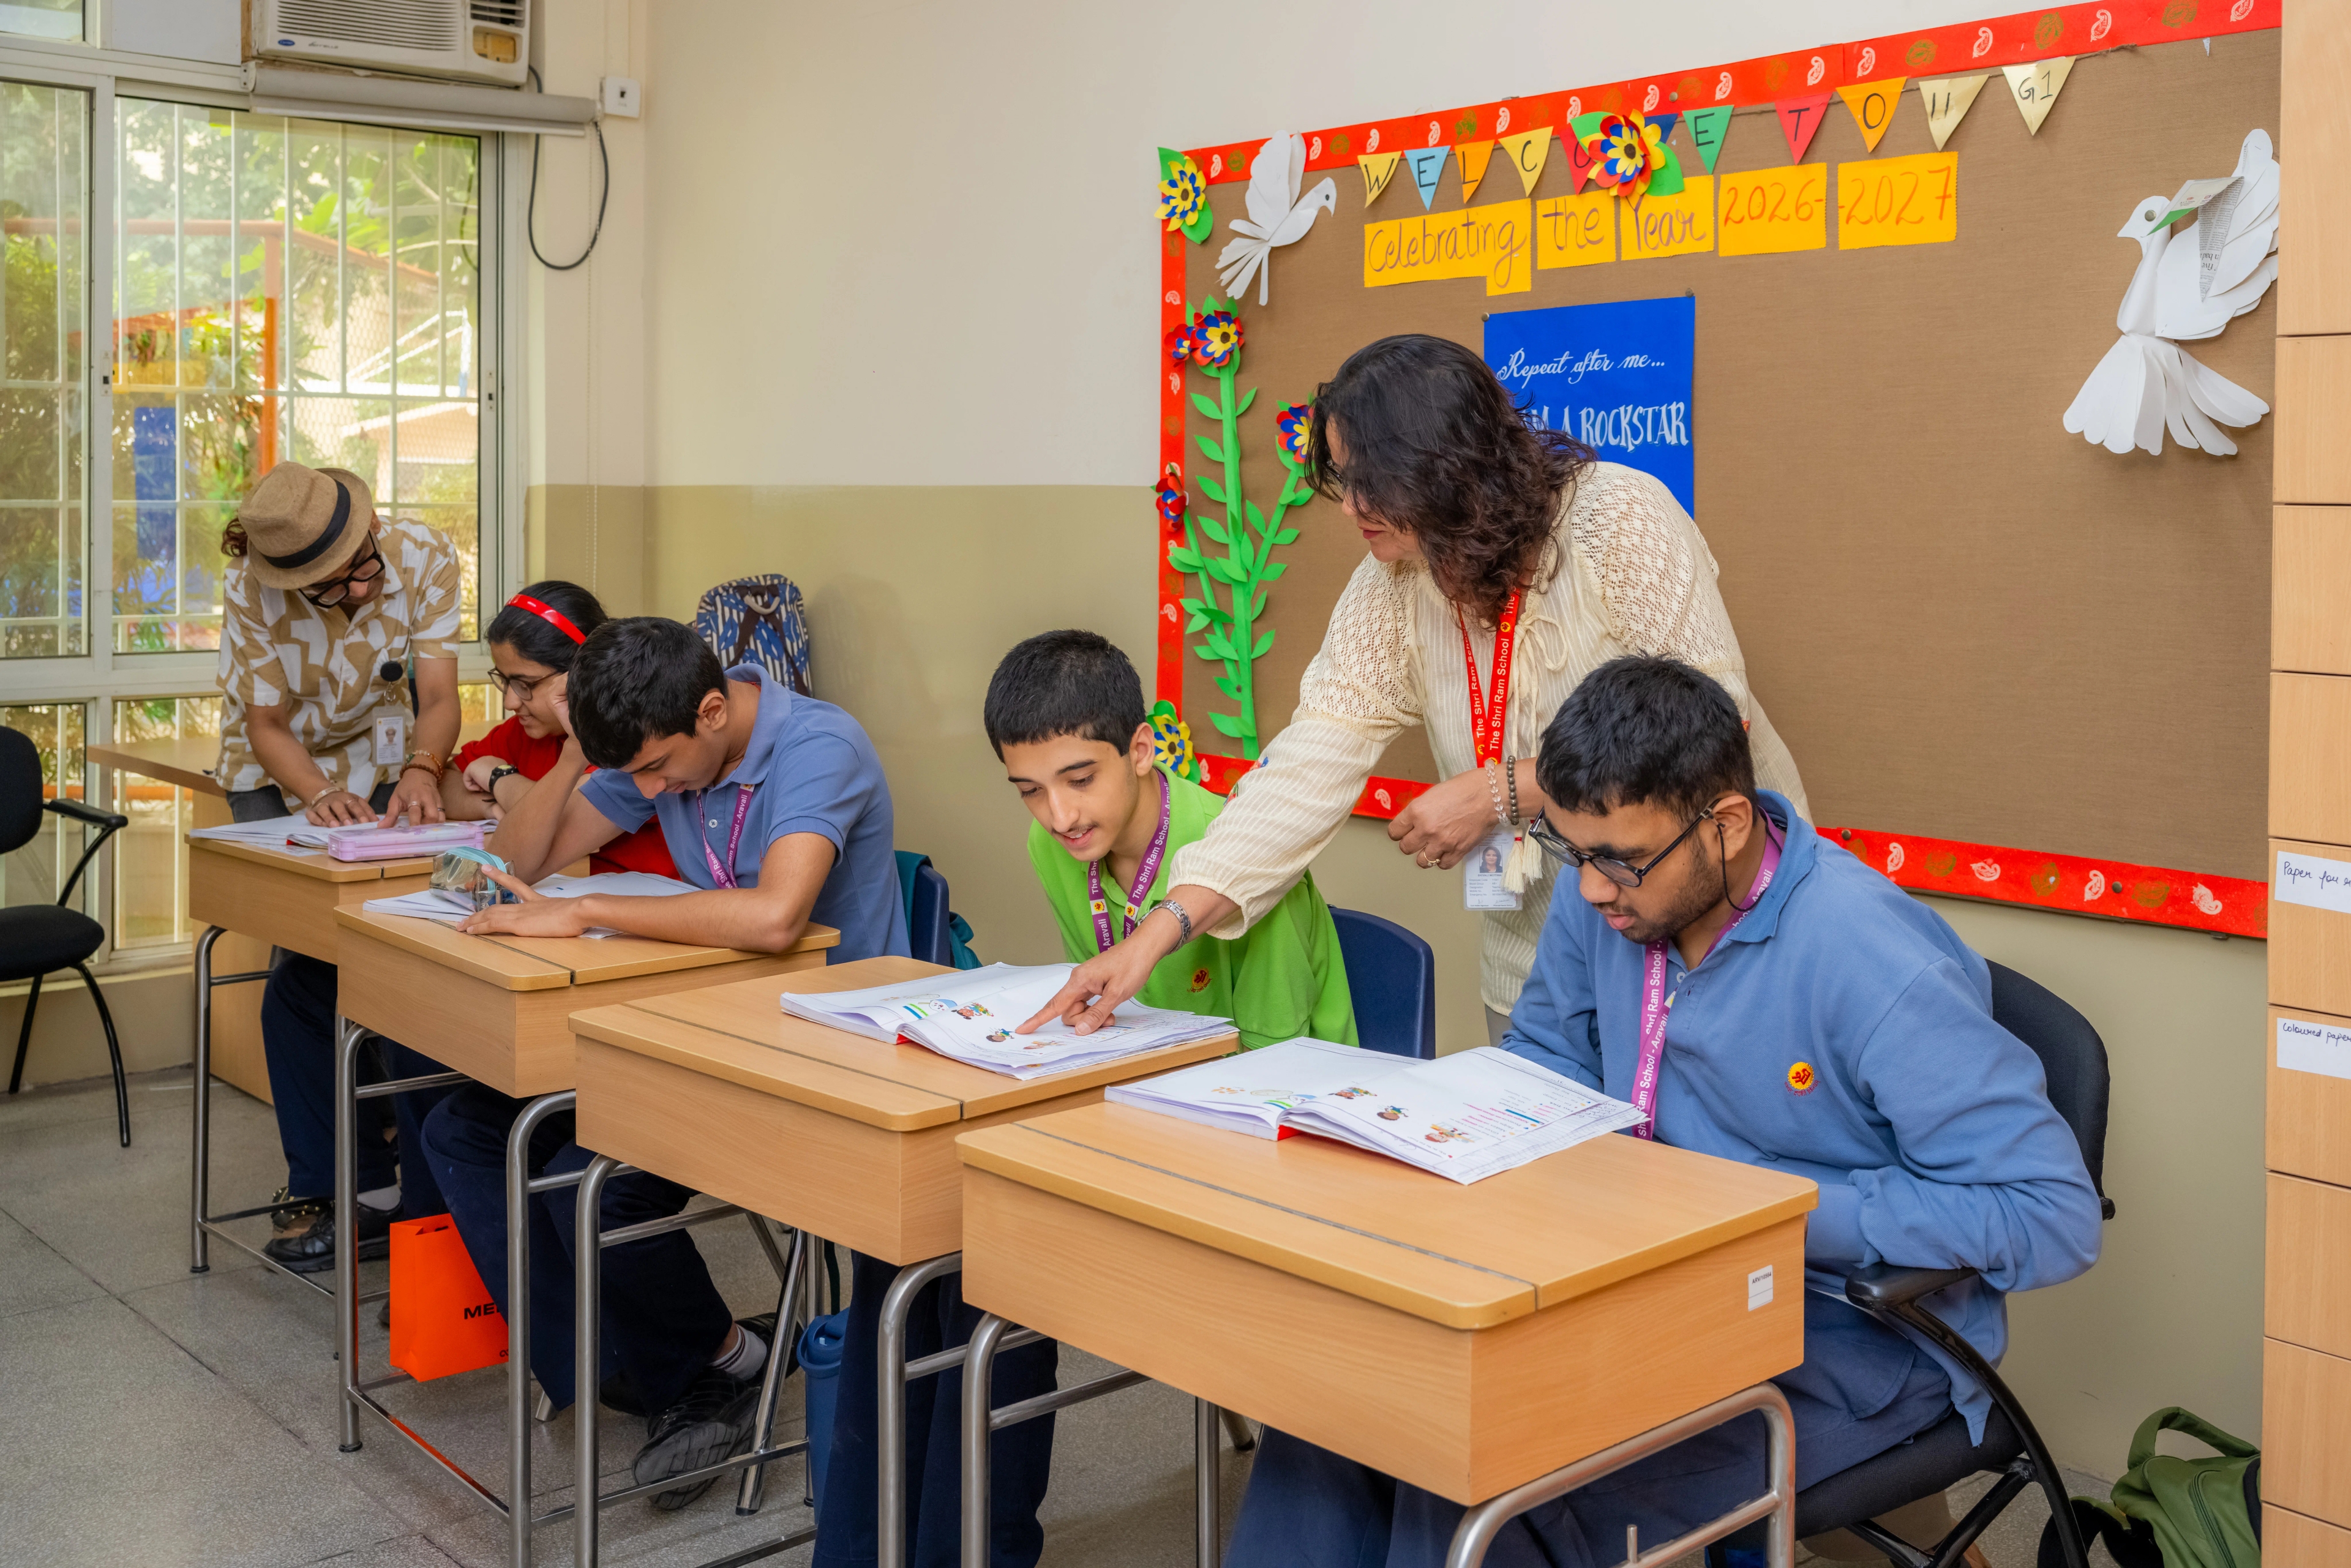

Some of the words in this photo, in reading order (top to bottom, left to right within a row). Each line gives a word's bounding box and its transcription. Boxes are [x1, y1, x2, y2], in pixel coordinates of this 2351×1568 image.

[1368, 212, 1527, 288] Celebrating
[1542, 198, 1605, 251] the
[1625, 193, 1707, 252] Year
[1497, 347, 1573, 389] Repeat
[1567, 348, 1614, 384] after
[1618, 354, 1665, 369] me...
[1561, 405, 1573, 438] A
[1578, 401, 1690, 452] ROCKSTAR
[1497, 638, 1510, 677] School
[1494, 679, 1505, 703] Ram
[1472, 694, 1482, 715] Shri
[1476, 718, 1485, 738] The
[1492, 706, 1502, 728] Shri
[1490, 731, 1500, 751] The
[730, 825, 740, 849] School
[737, 794, 748, 820] Aravali
[710, 853, 720, 871] Ram
[1132, 882, 1144, 900] The
[1139, 863, 1153, 883] Shri
[1146, 844, 1161, 864] Ram
[1155, 816, 1170, 846] School
[716, 869, 727, 883] Shri
[2284, 861, 2312, 884] Paper
[1752, 869, 1773, 902] Aravali
[1098, 918, 1111, 947] Aravali
[1649, 950, 1662, 986] School
[1648, 989, 1659, 1012] Ram
[1652, 1013, 1668, 1049] Aravali
[2282, 1022, 2322, 1037] Coloured
[1639, 1053, 1655, 1089] School
[1636, 1091, 1648, 1112] Ram
[463, 1302, 501, 1320] ME
